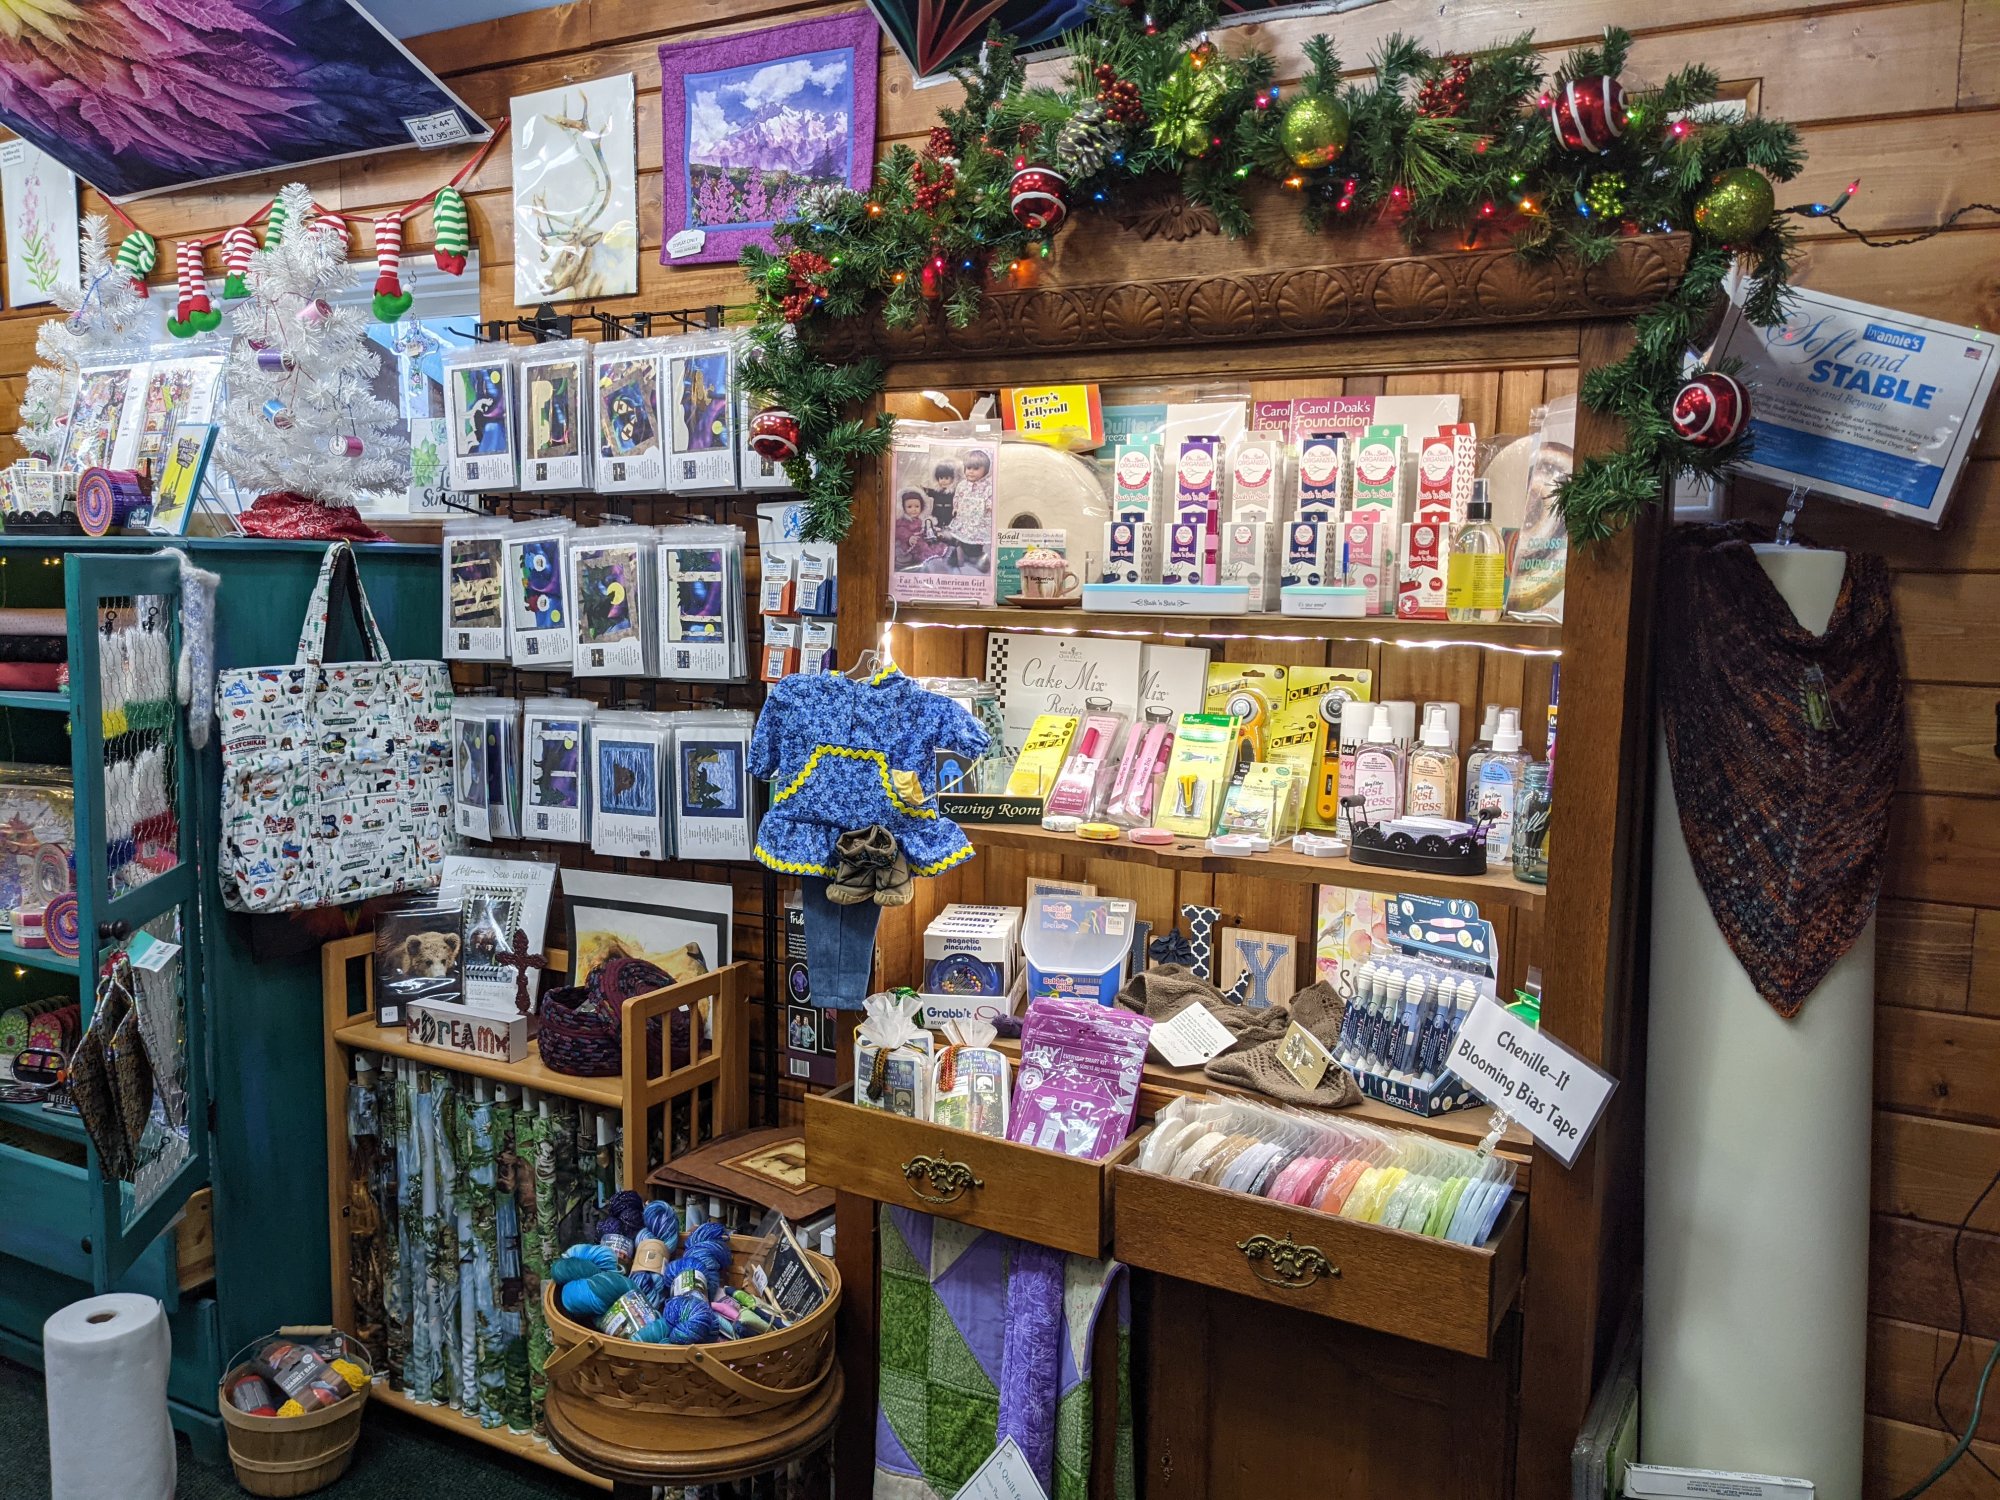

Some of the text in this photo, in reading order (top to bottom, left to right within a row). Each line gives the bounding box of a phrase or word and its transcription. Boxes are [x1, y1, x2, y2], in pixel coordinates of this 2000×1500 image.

[1854, 350, 1911, 373] and
[1021, 392, 1059, 406] Jerry's
[1821, 387, 1843, 402] and
[1844, 393, 1888, 413] Beyond!
[1022, 402, 1069, 418] Jellyroll
[1261, 404, 1291, 417] Carol
[1299, 400, 1371, 415] Carol Doak's
[1024, 419, 1041, 430] Jig
[1297, 413, 1371, 429] Foundation
[1104, 434, 1128, 442] reeze
[899, 575, 912, 586] Far
[936, 577, 970, 587] American
[971, 578, 985, 587] Girl
[1021, 657, 1106, 692] Cake Mix
[1208, 679, 1248, 697] OLFA
[1289, 682, 1330, 701] OLFA
[228, 740, 267, 751] KETCHIKAN
[1024, 738, 1066, 751] OLFA
[1271, 732, 1313, 749] OLFA
[1358, 785, 1384, 798] Best
[1412, 789, 1434, 801] Best
[940, 802, 1041, 819] Sewing Room
[1412, 801, 1442, 813] Press
[492, 865, 511, 879] Sew
[512, 870, 529, 880] into
[531, 869, 542, 881] it!
[946, 938, 980, 946] magnetic
[1042, 977, 1069, 986] Bobbin
[1055, 983, 1073, 992] Clips
[1084, 1056, 1100, 1064] SMART
[1025, 1074, 1036, 1085] 5
[1458, 1038, 1578, 1140] Blooming Bias Tape
[285, 1362, 317, 1391] MARKET BAG
[996, 1461, 1016, 1494] A Quilt
